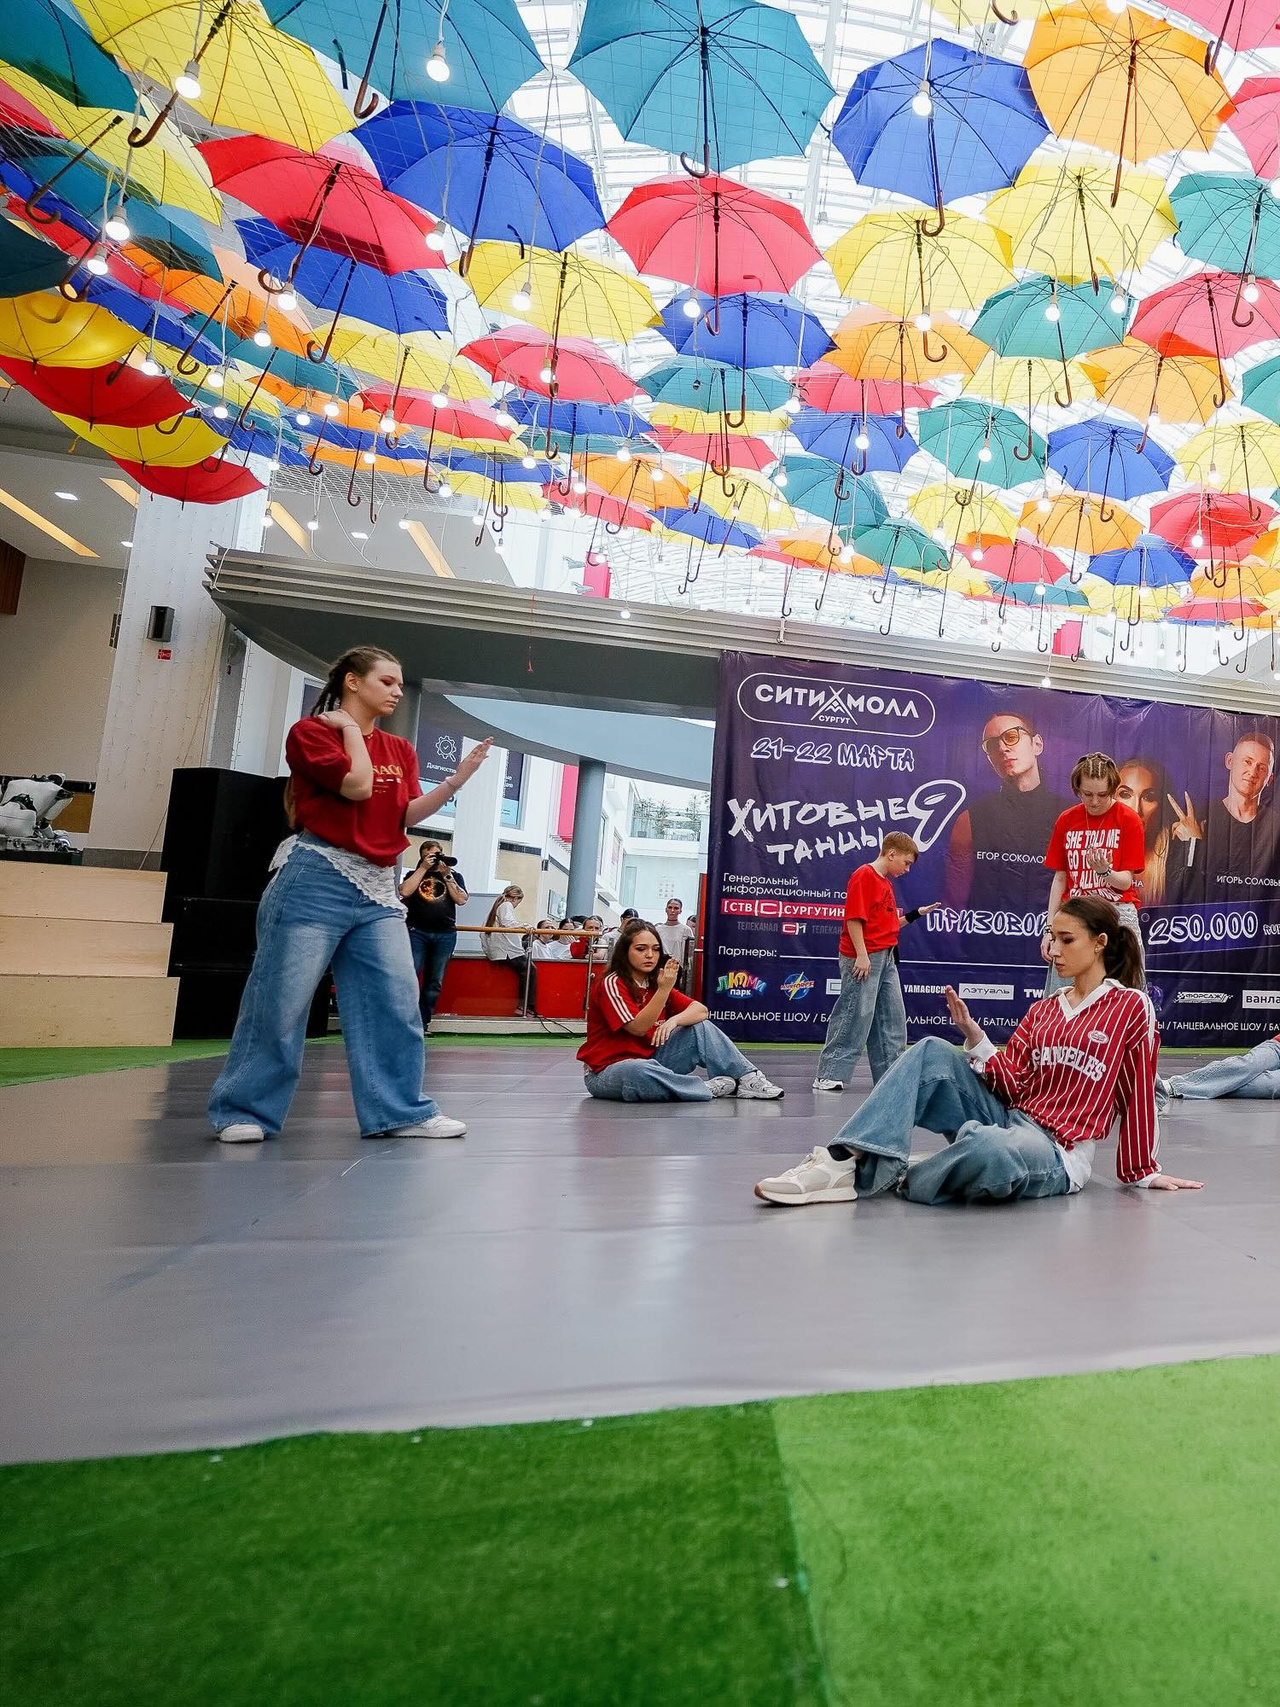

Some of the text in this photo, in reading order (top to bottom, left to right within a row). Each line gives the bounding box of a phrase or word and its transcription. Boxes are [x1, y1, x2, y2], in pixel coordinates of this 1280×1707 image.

[755, 684, 920, 719] СИТИ МОЛЛ
[818, 715, 850, 725] СУРГУТ
[750, 737, 915, 772] 21-22 МАРТА
[1065, 828, 1121, 850] SHE TOLD ME
[976, 851, 1000, 861] ЕГОР
[723, 872, 799, 887] Генеральный
[1216, 875, 1243, 885] ИГОРЬ
[722, 884, 831, 898] информационный
[783, 905, 846, 918] СУРГУТИН
[737, 921, 779, 932] ТЕЛЕКАНАЛ
[811, 924, 843, 935] ТЕЛЕКАН
[1147, 910, 1259, 945] 250.000
[718, 945, 778, 958] Партнеры:
[729, 987, 752, 997] парк
[904, 984, 946, 995] YAMAGUCH
[708, 1010, 781, 1023] НЦЕВАЛЬНОЕ
[783, 1012, 811, 1022] ШОУ
[983, 1016, 1019, 1027] БАТТЛЫ
[1172, 1021, 1239, 1032] ТАНЦЕВАЛЬНОЕ
[1240, 1023, 1261, 1031] ШОУ
